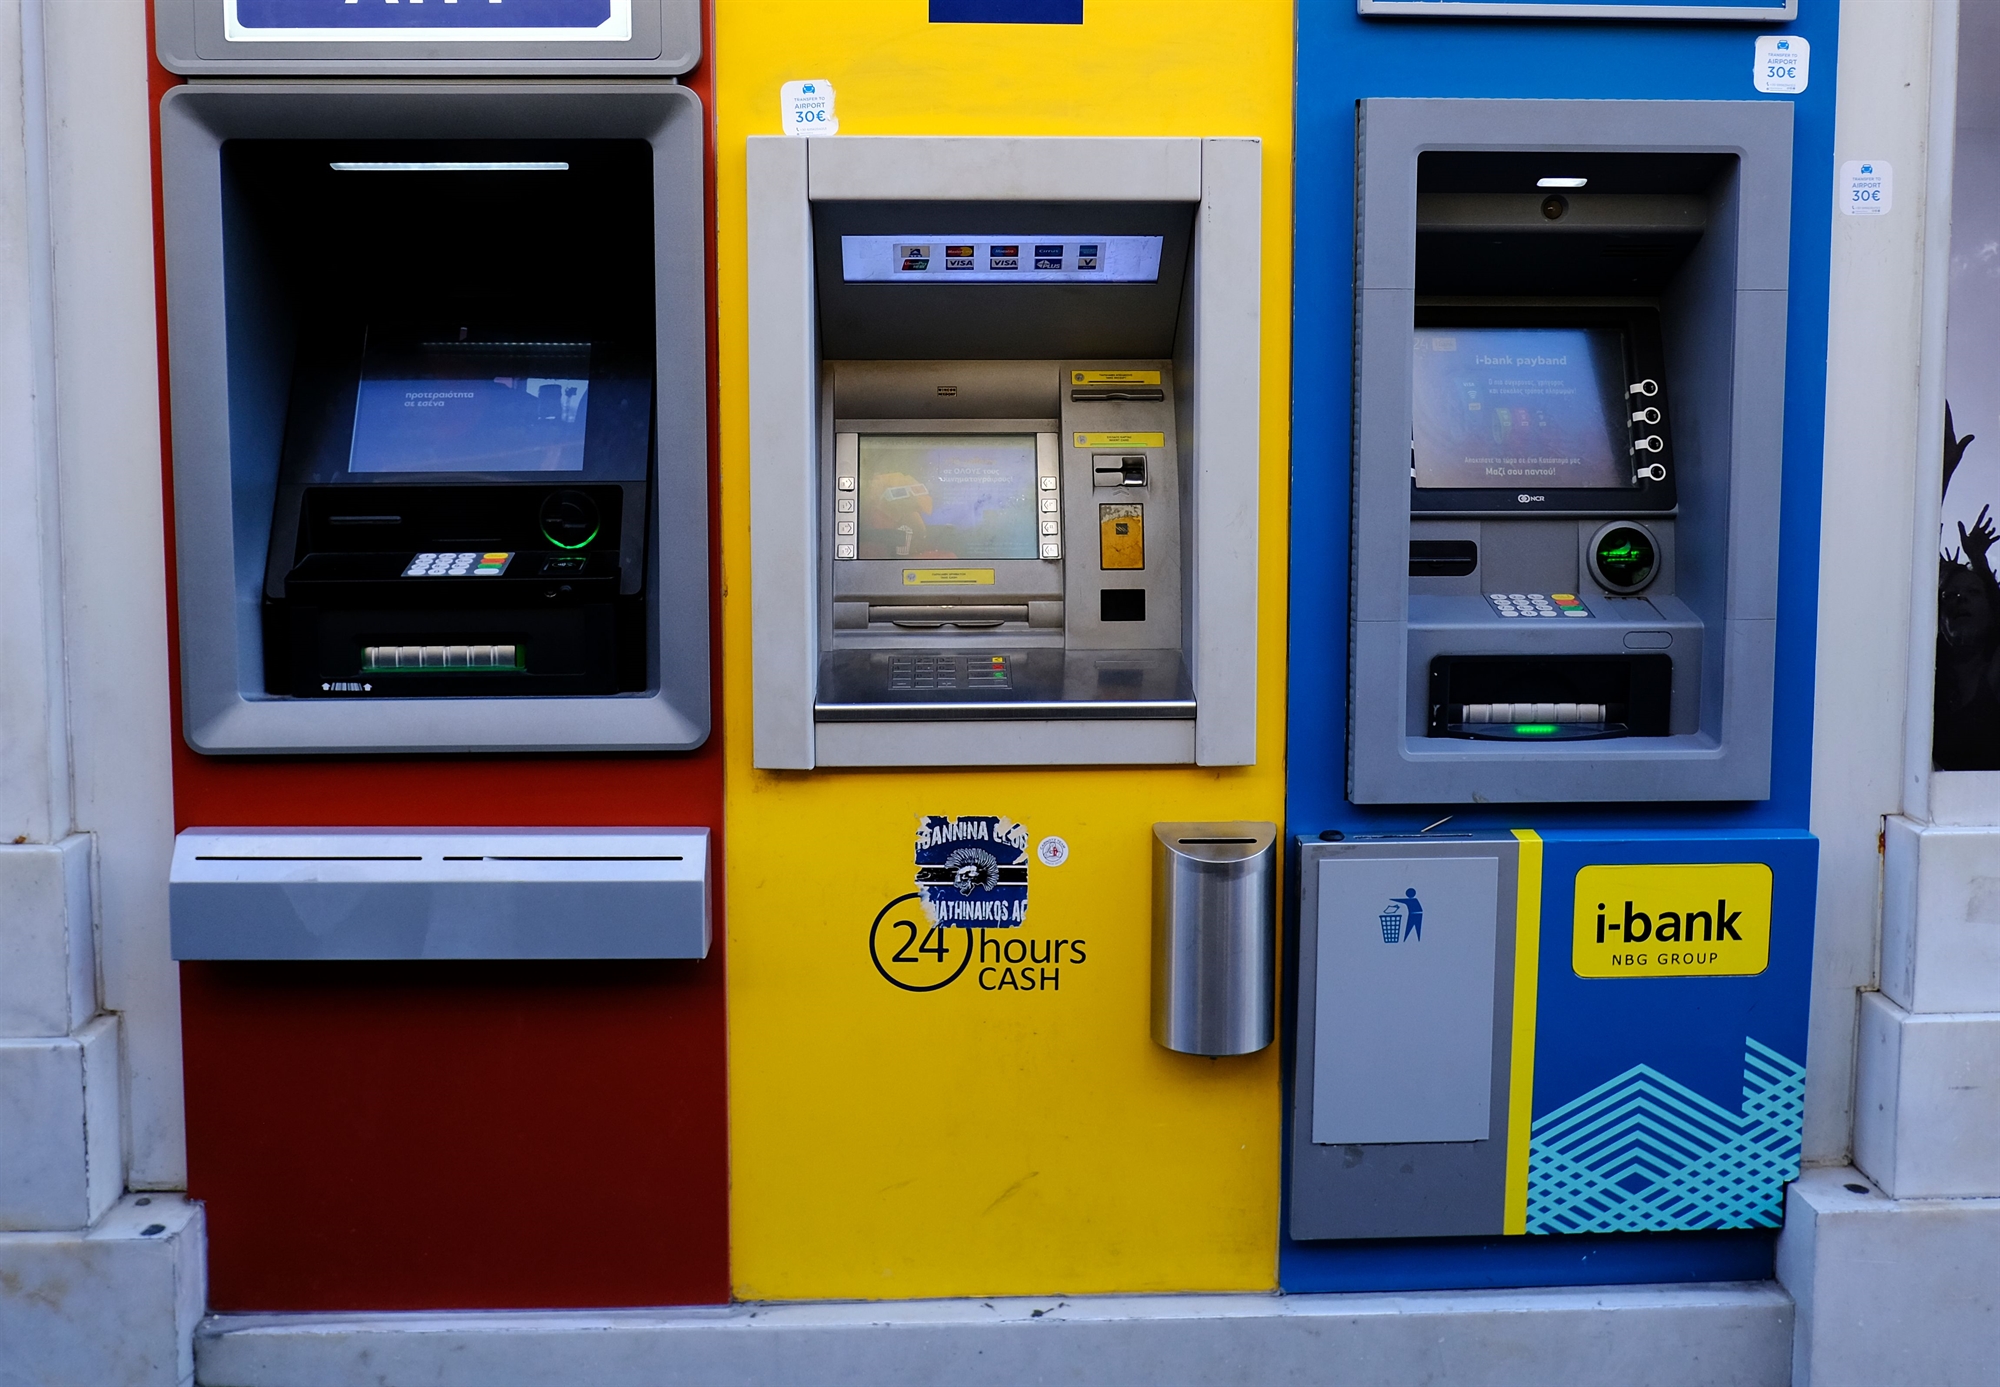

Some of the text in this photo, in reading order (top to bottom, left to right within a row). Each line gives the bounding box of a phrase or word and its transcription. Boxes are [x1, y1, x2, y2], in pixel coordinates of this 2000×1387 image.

[1767, 66, 1796, 78] 30€
[795, 110, 826, 123] 30€
[1852, 190, 1881, 201] 30€
[1475, 355, 1567, 367] i-bank payband
[405, 391, 475, 400] προτεραιότητα
[1485, 467, 1506, 476] Μαζί
[1524, 467, 1556, 476] παντού!
[1596, 899, 1743, 944] i-bank
[891, 920, 1087, 964] 24 hours
[1611, 952, 1718, 966] NBG GROUP
[978, 967, 1060, 991] CASH
